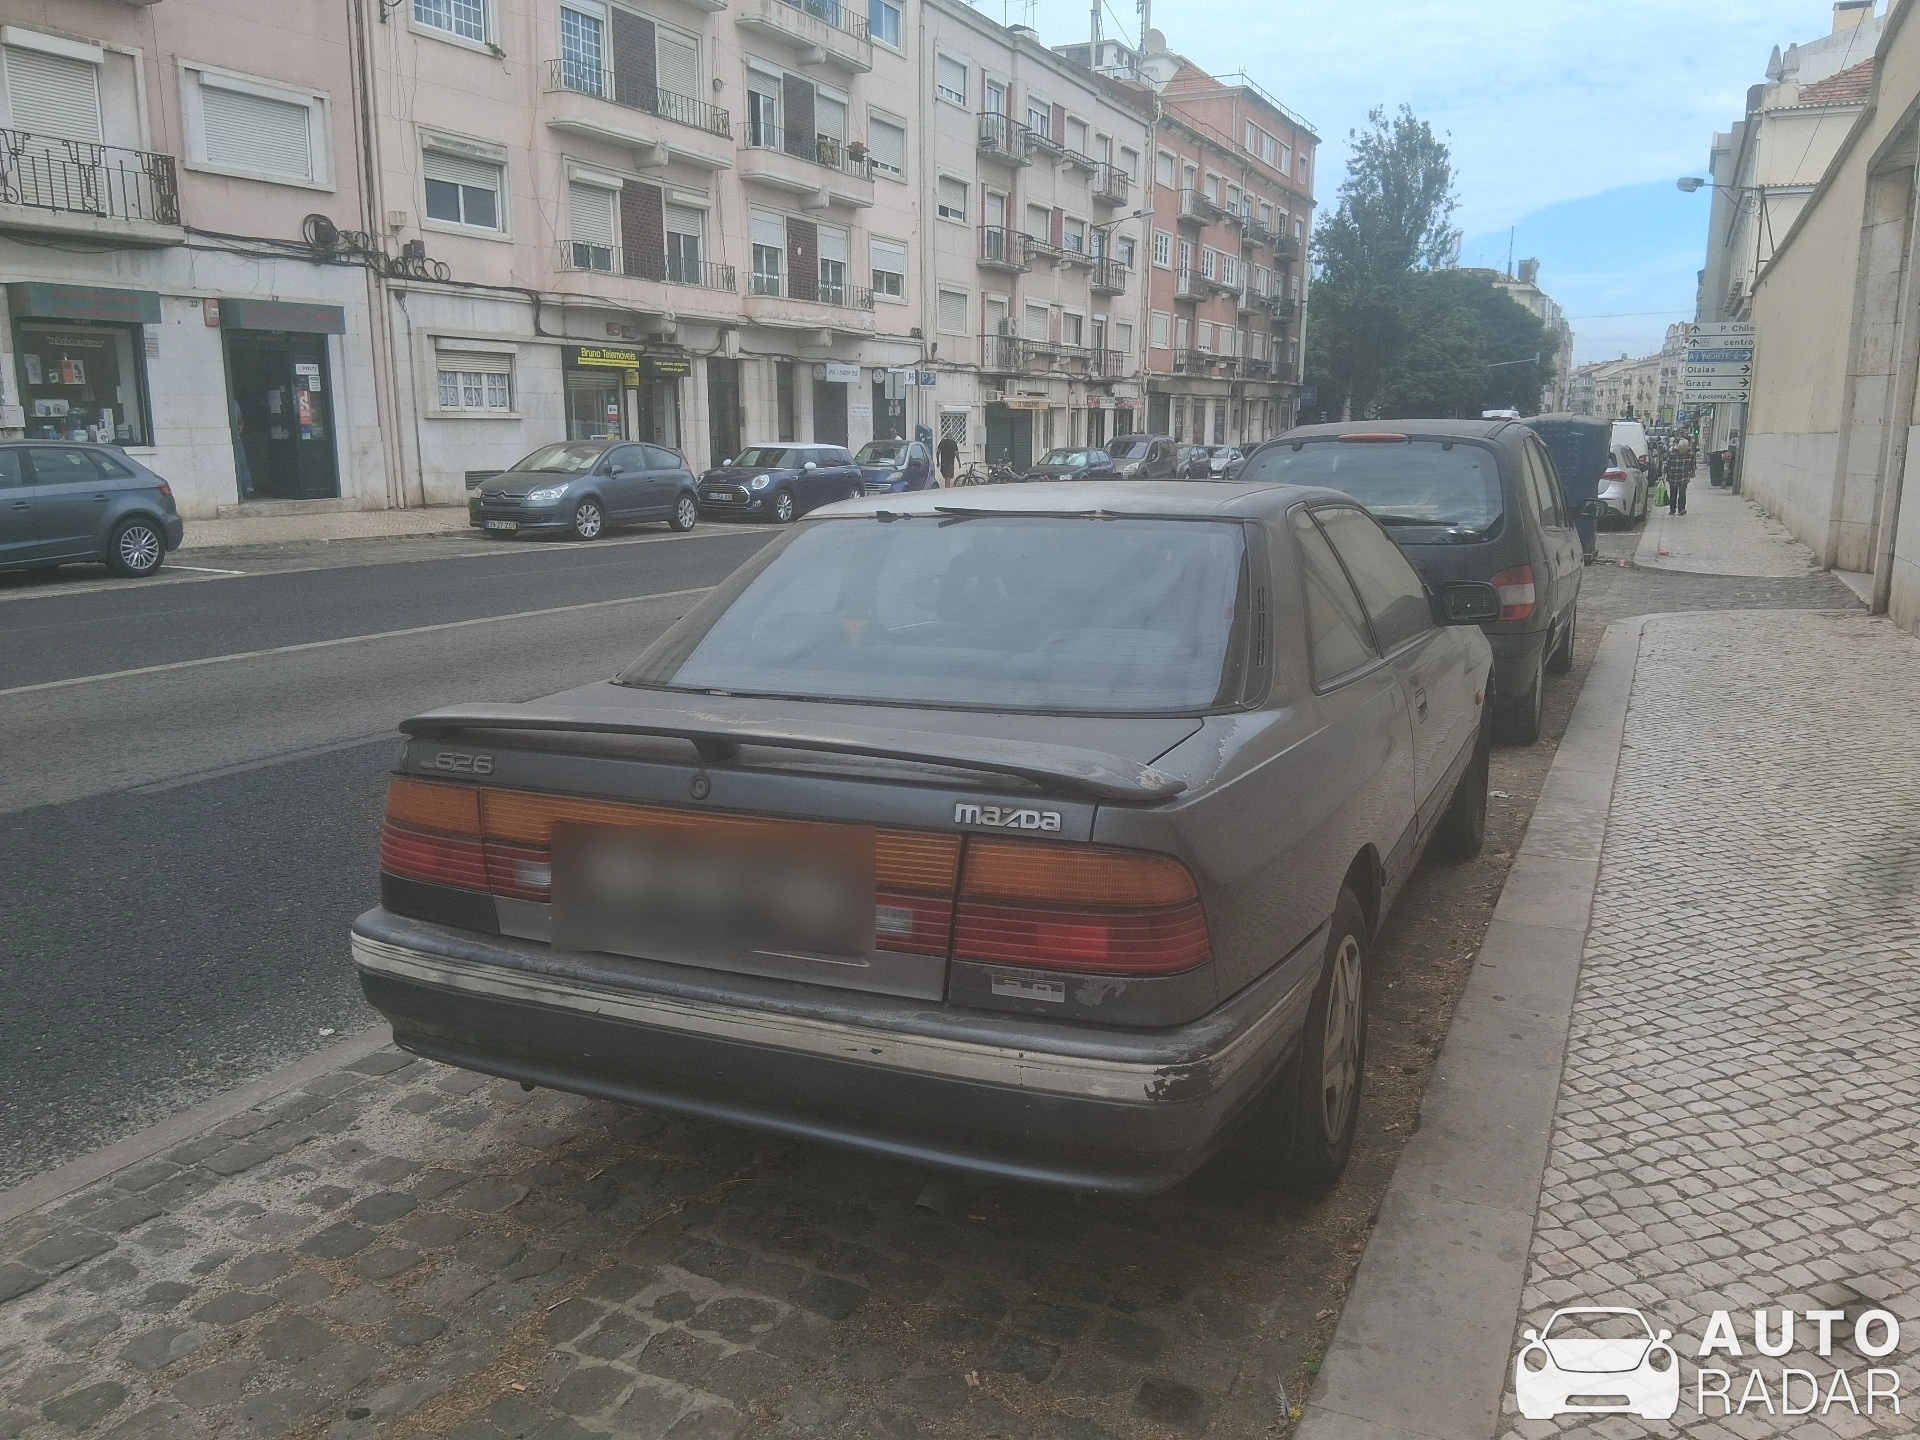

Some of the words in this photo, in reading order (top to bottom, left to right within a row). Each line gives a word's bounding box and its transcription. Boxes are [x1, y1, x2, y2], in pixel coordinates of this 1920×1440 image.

[1731, 324, 1755, 332] Chile
[1723, 338, 1754, 346] centro
[580, 347, 602, 358] Bruno
[601, 348, 638, 361] Telemóveis
[1702, 352, 1731, 361] NORTE
[1687, 366, 1716, 374] Olaias
[921, 373, 929, 383] P
[1685, 379, 1712, 388] Graça
[1678, 411, 1685, 421] P
[436, 752, 494, 774] 626
